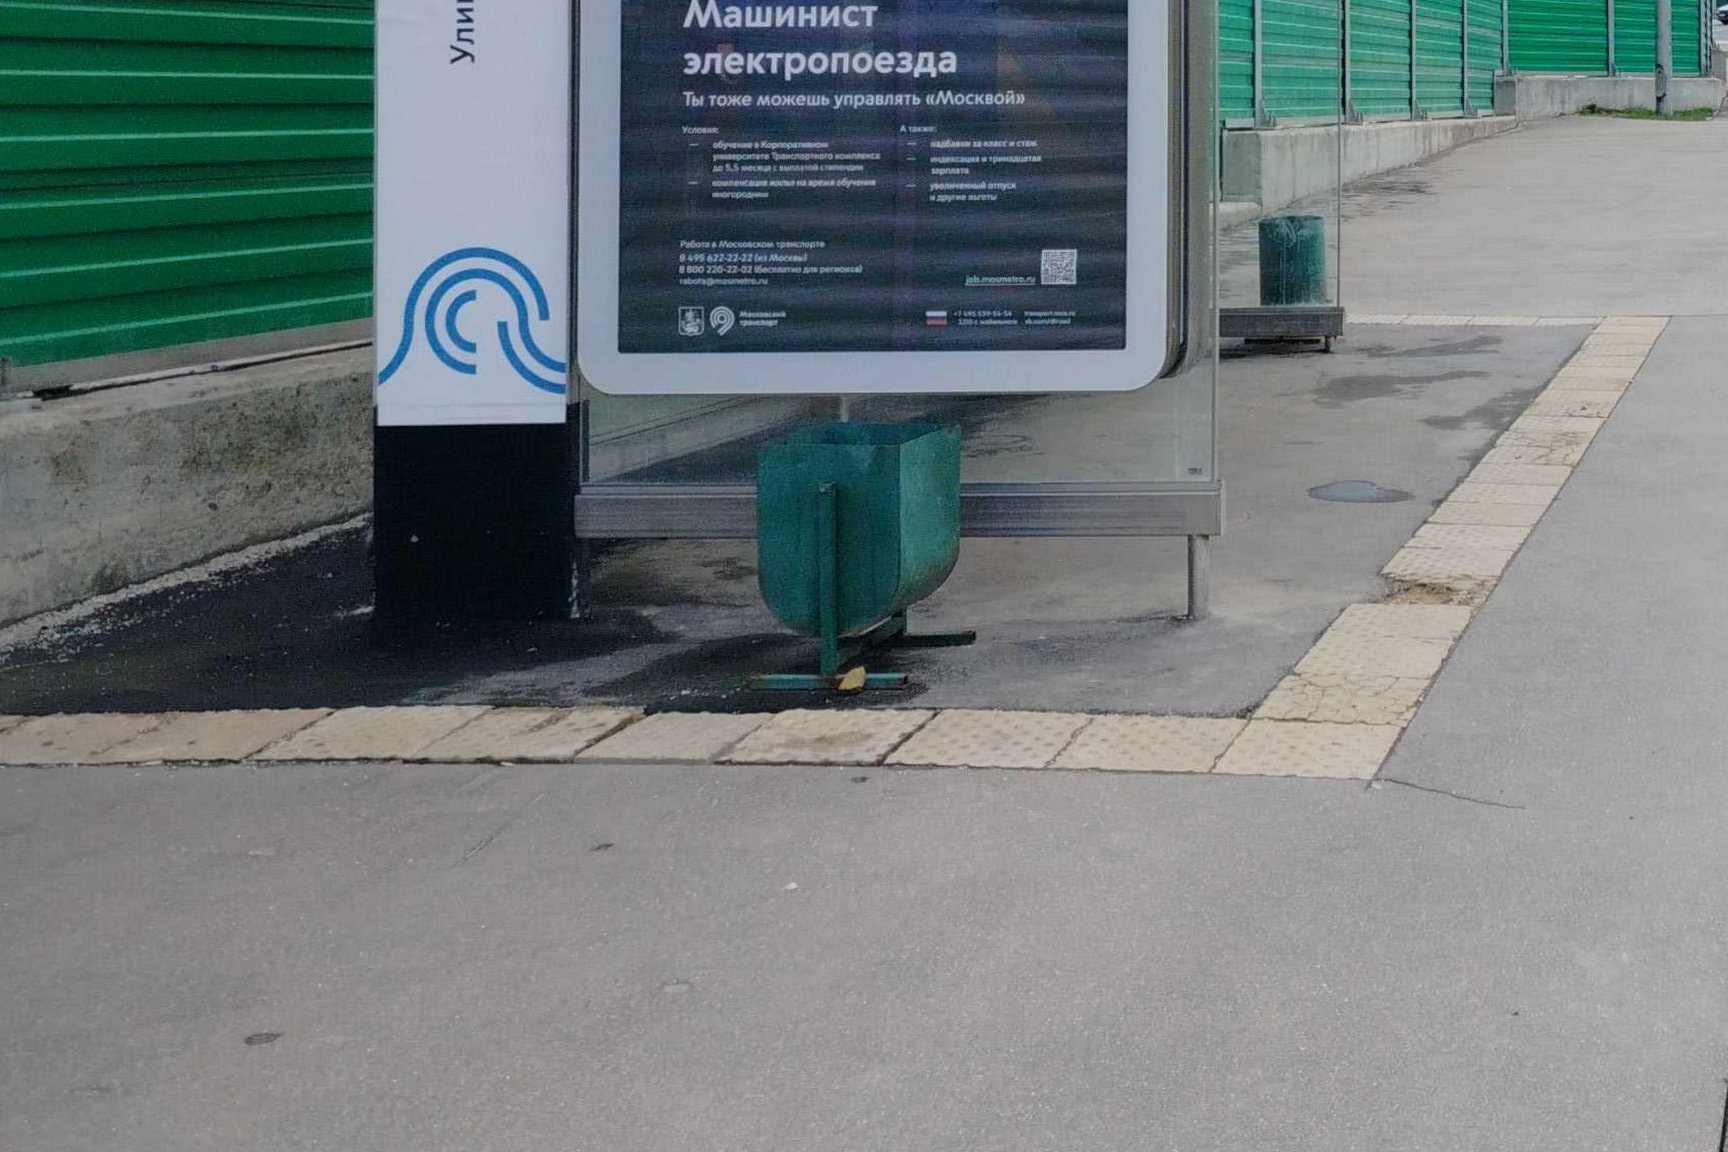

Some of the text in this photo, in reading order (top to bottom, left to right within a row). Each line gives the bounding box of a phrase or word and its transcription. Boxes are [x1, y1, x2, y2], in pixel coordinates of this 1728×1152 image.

[683, 0, 879, 28] Машинист
[683, 50, 957, 81] электропоезда
[683, 90, 1026, 109] Ты тоже можешь управлять «Москвой»
[682, 126, 719, 135] Условия:
[761, 140, 829, 150] Корпоративном
[772, 152, 833, 161] Транспортного
[687, 254, 705, 262] 495
[706, 254, 754, 262] 622-22-22
[687, 265, 704, 274] 800
[706, 265, 753, 274] 220-22-02
